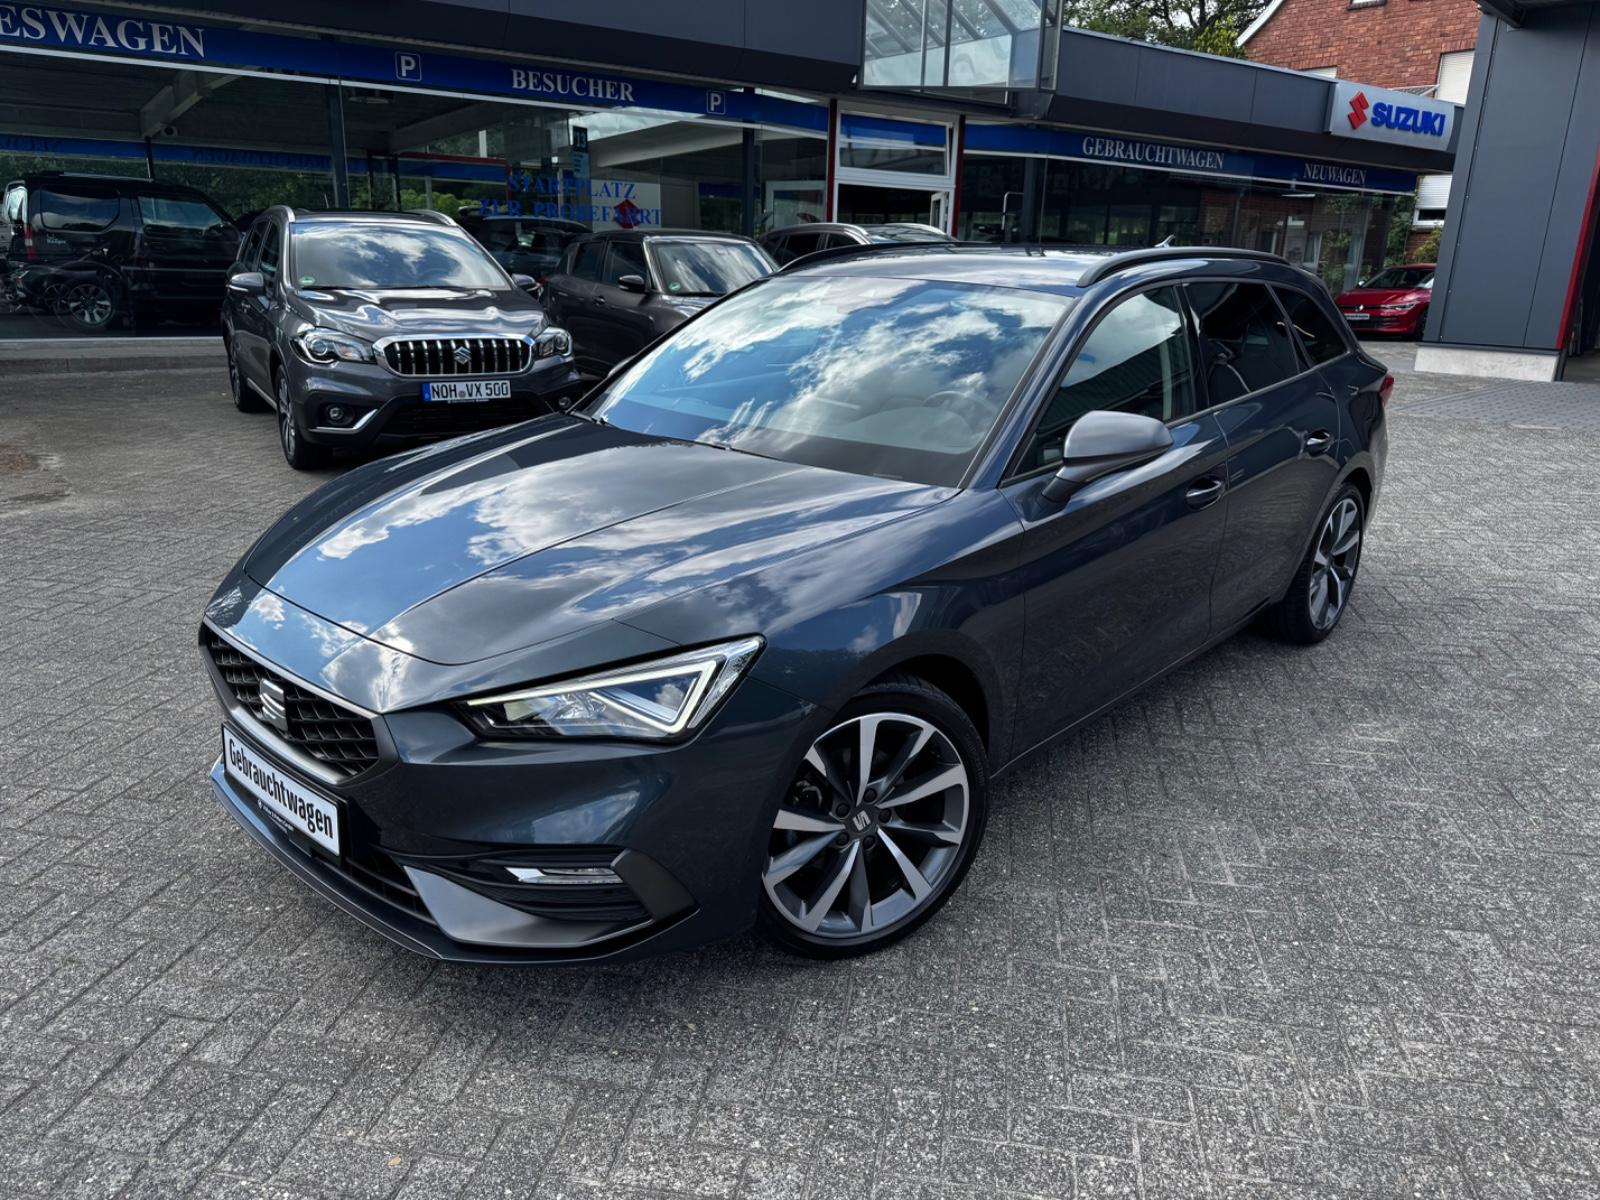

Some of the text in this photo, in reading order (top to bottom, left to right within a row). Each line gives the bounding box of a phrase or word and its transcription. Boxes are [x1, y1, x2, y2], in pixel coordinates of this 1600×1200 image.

[400, 55, 416, 77] P
[512, 68, 635, 102] BESUCHER
[710, 92, 722, 111] P
[1371, 102, 1446, 137] SUZUKI
[1082, 136, 1225, 169] GEBRAUCHTWAGEN
[1303, 163, 1367, 184] NEUWAGEN
[532, 201, 661, 226] PROBEFAHRT
[431, 382, 509, 398] NOH VX 500
[229, 738, 334, 840] Gebrauchtwagen
